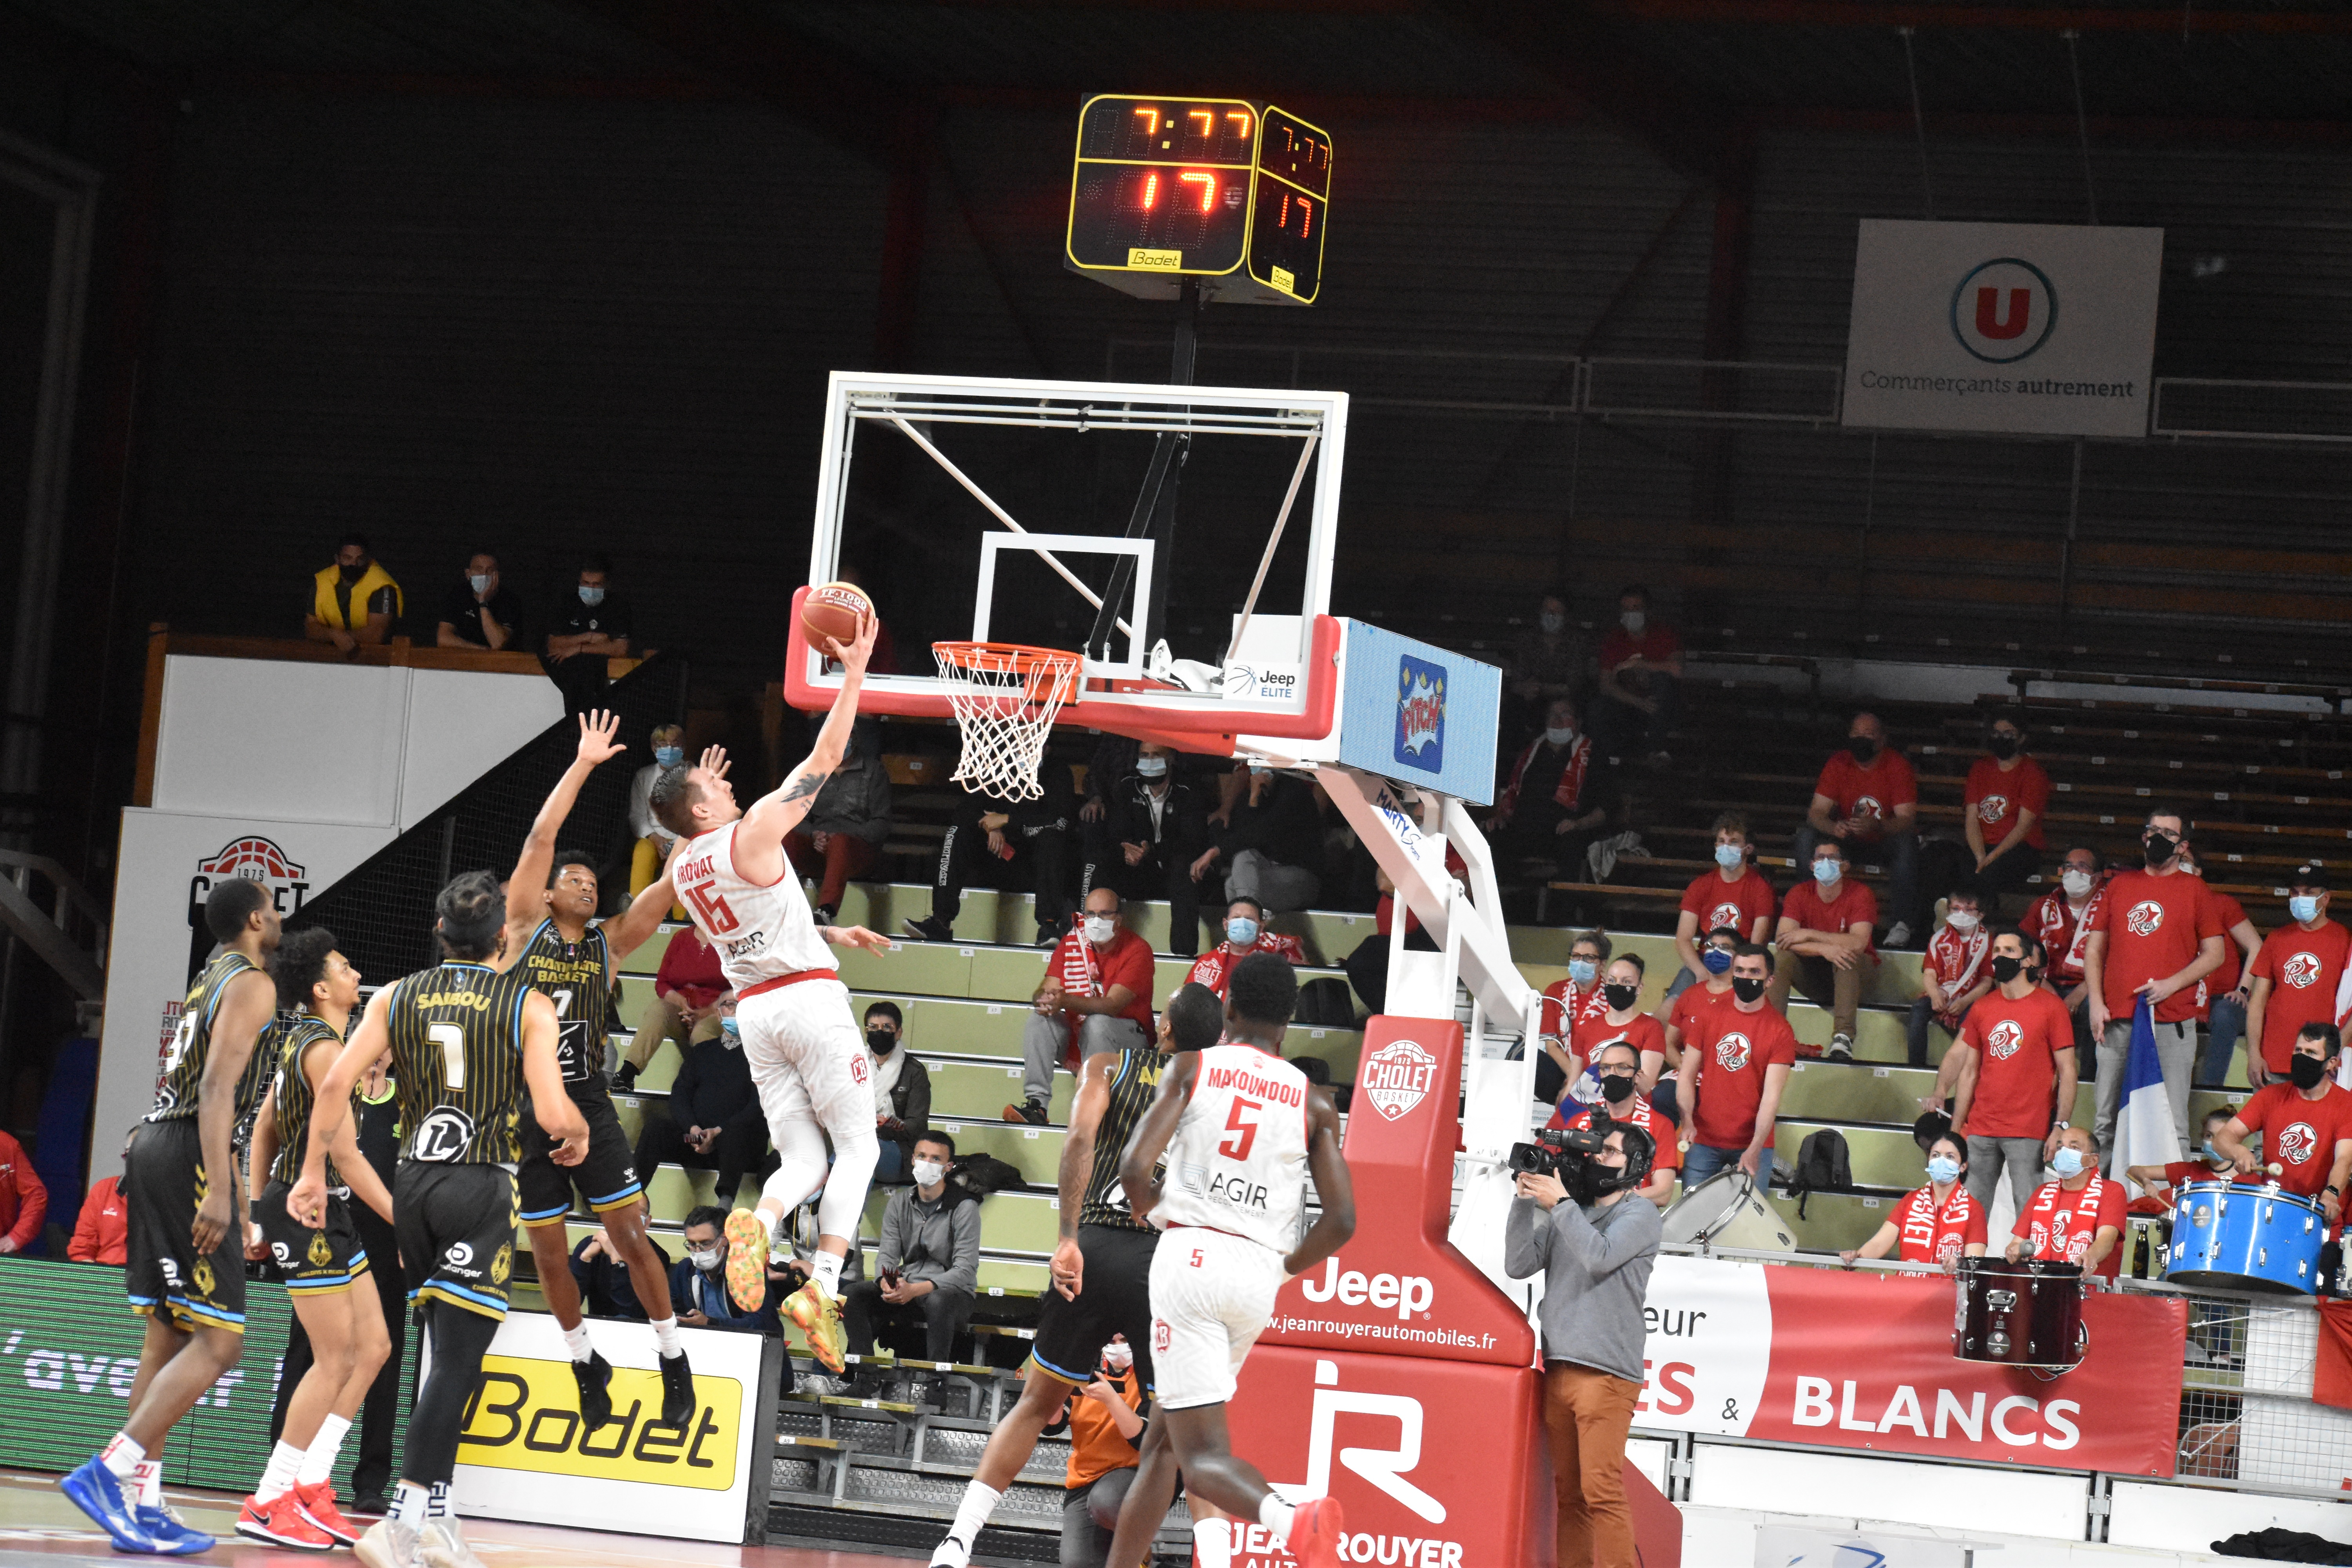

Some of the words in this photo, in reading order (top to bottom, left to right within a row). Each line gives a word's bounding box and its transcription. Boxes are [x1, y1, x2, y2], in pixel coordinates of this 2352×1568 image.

[1143, 172, 1215, 212] 17
[1280, 196, 1311, 238] 17
[1131, 251, 1179, 267] Bodet
[1273, 269, 1293, 290] Bodet
[1976, 287, 2031, 340] U
[1861, 370, 2012, 396] Commerçants
[2016, 378, 2134, 398] autrement
[1259, 670, 1295, 686] Jeep
[1261, 684, 1292, 698] ÉLITE
[238, 868, 264, 882] 1975
[684, 879, 740, 936] 15
[2127, 909, 2156, 936] Reds
[2283, 959, 2312, 989] Reds
[417, 991, 492, 1012] SAIBOU
[1394, 1056, 1411, 1065] 1975
[1716, 1040, 1743, 1072] Reds
[1988, 1029, 2014, 1060] Reds
[1208, 1067, 1302, 1108] MAKOUNDOU
[1362, 1060, 1437, 1093] CHOLET
[1376, 1091, 1416, 1103] BASKET
[1218, 1095, 1263, 1161] 5
[2279, 1130, 2309, 1165] Reds
[1208, 1195, 1266, 1219] RECOEMENT
[1209, 1172, 1267, 1210] AGIR
[1189, 1248, 1205, 1268] 5
[1302, 1256, 1434, 1320] Jeep
[1644, 1306, 1707, 1338] eur
[461, 1371, 719, 1469] Bodet
[1722, 1397, 1739, 1421] &
[1792, 1375, 2081, 1450] BLANCS
[1231, 1521, 1296, 1556] JEA
[1336, 1531, 1463, 1568] ROUYER
